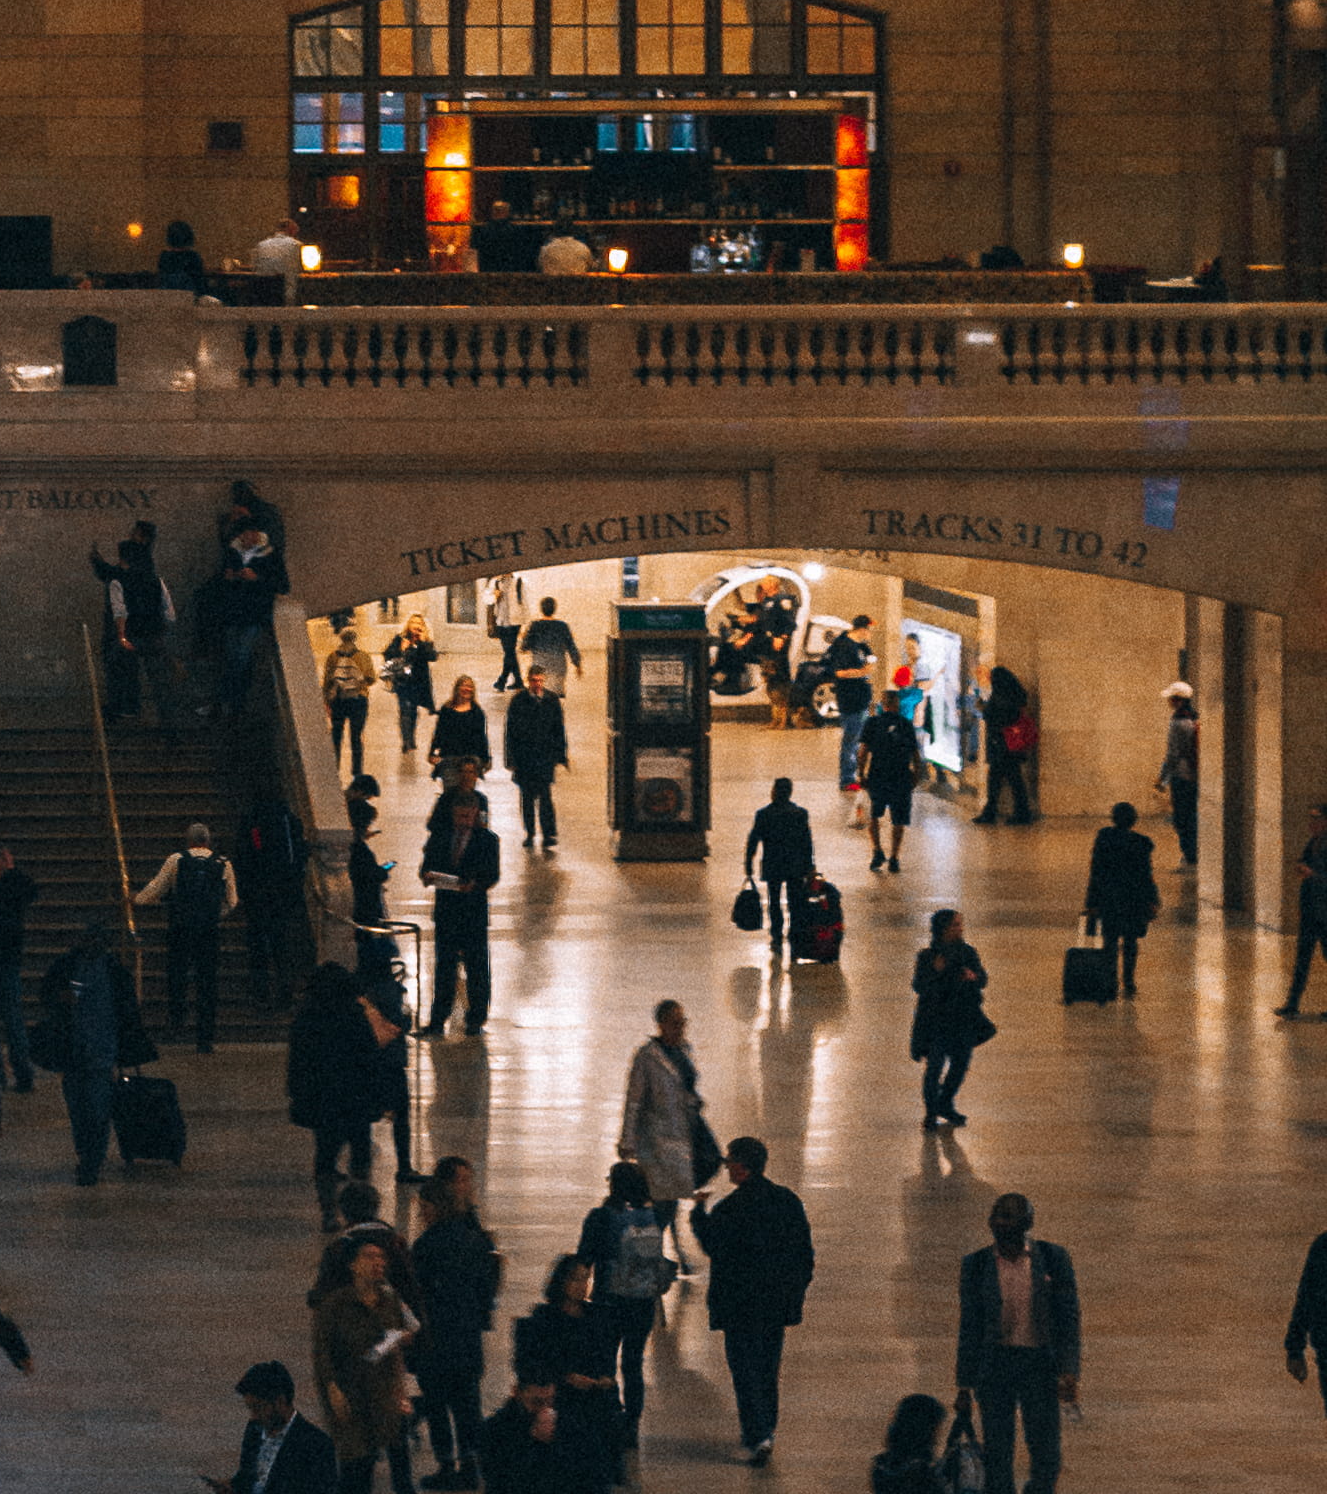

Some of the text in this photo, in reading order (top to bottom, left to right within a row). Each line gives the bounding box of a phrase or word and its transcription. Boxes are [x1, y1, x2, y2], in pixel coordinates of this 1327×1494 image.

[26, 489, 156, 510] BALCONY
[402, 508, 732, 576] TICKET MACHINES
[862, 508, 1149, 568] TRACKS 31 TO 42
